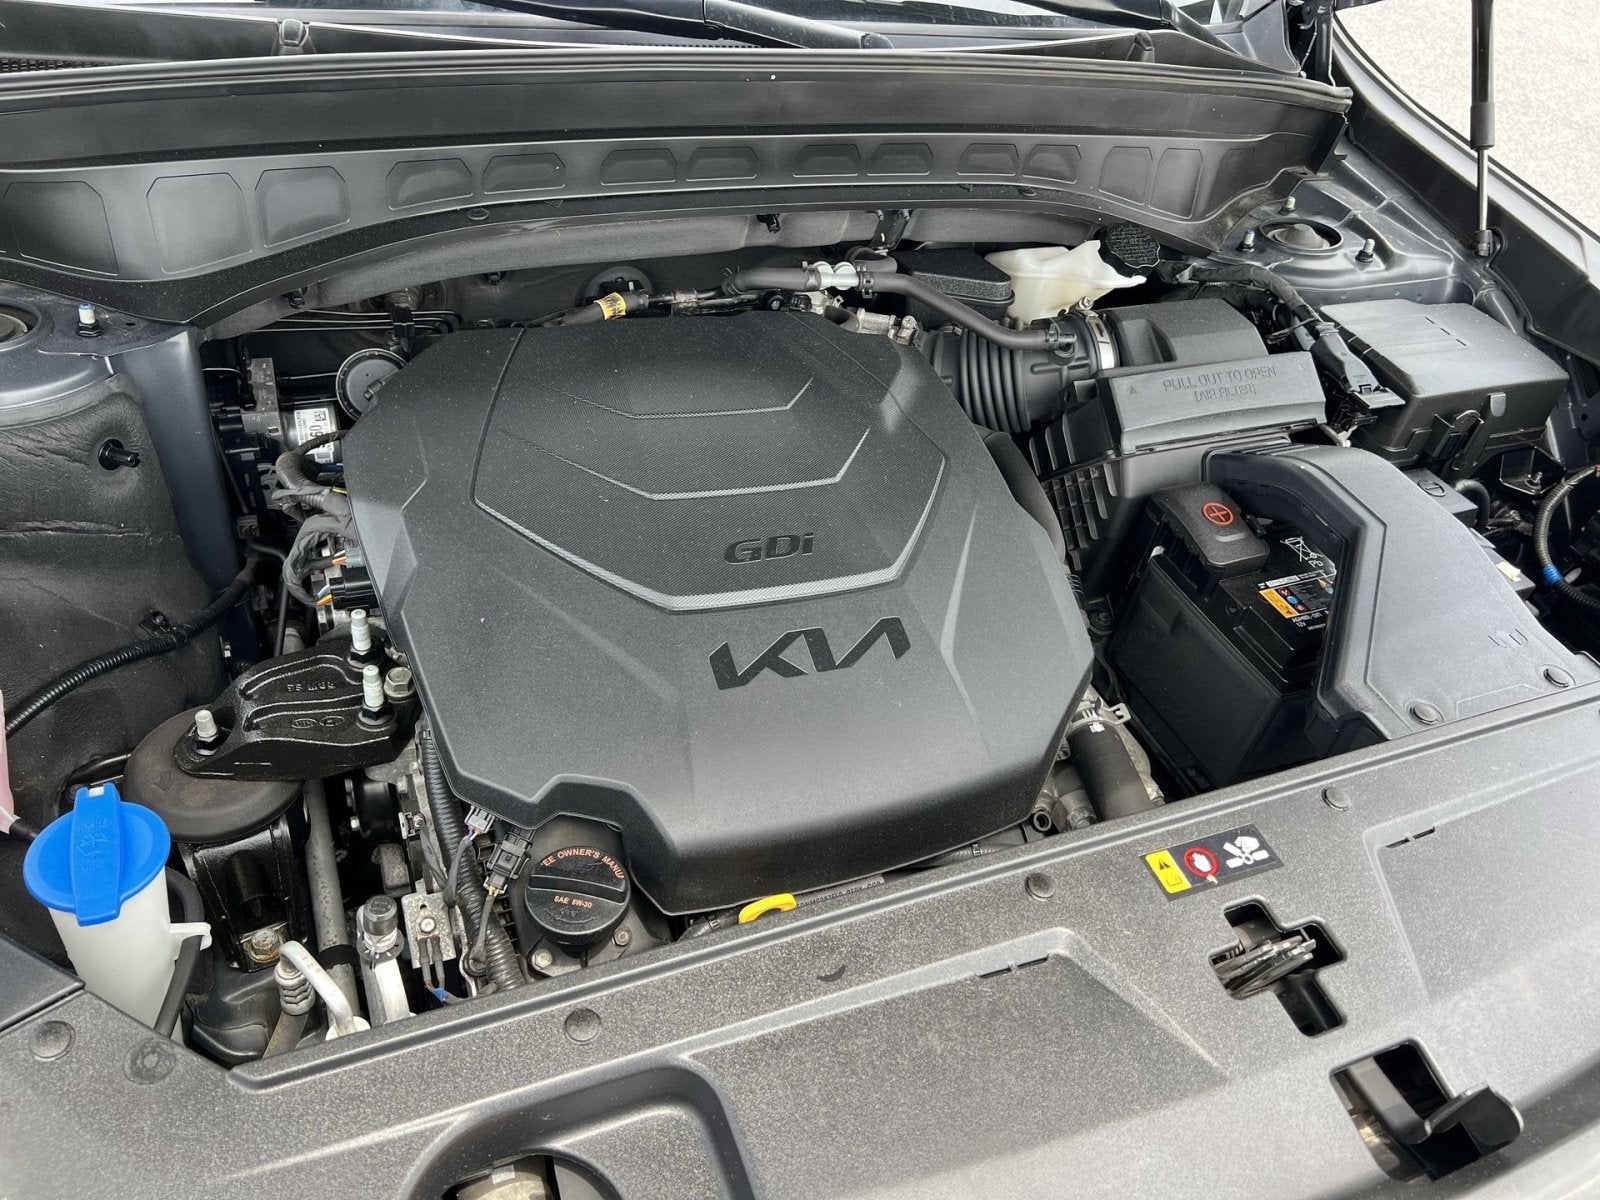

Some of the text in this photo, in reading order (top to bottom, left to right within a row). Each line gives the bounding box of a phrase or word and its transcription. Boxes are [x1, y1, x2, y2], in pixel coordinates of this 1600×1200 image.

[1162, 366, 1277, 392] PULL OUT TO OPEN
[724, 532, 814, 564] GDi
[708, 616, 911, 690] KIA
[540, 855, 556, 868] EE
[557, 848, 601, 859] OWNER'S
[553, 895, 593, 909] SAE 5W-30
